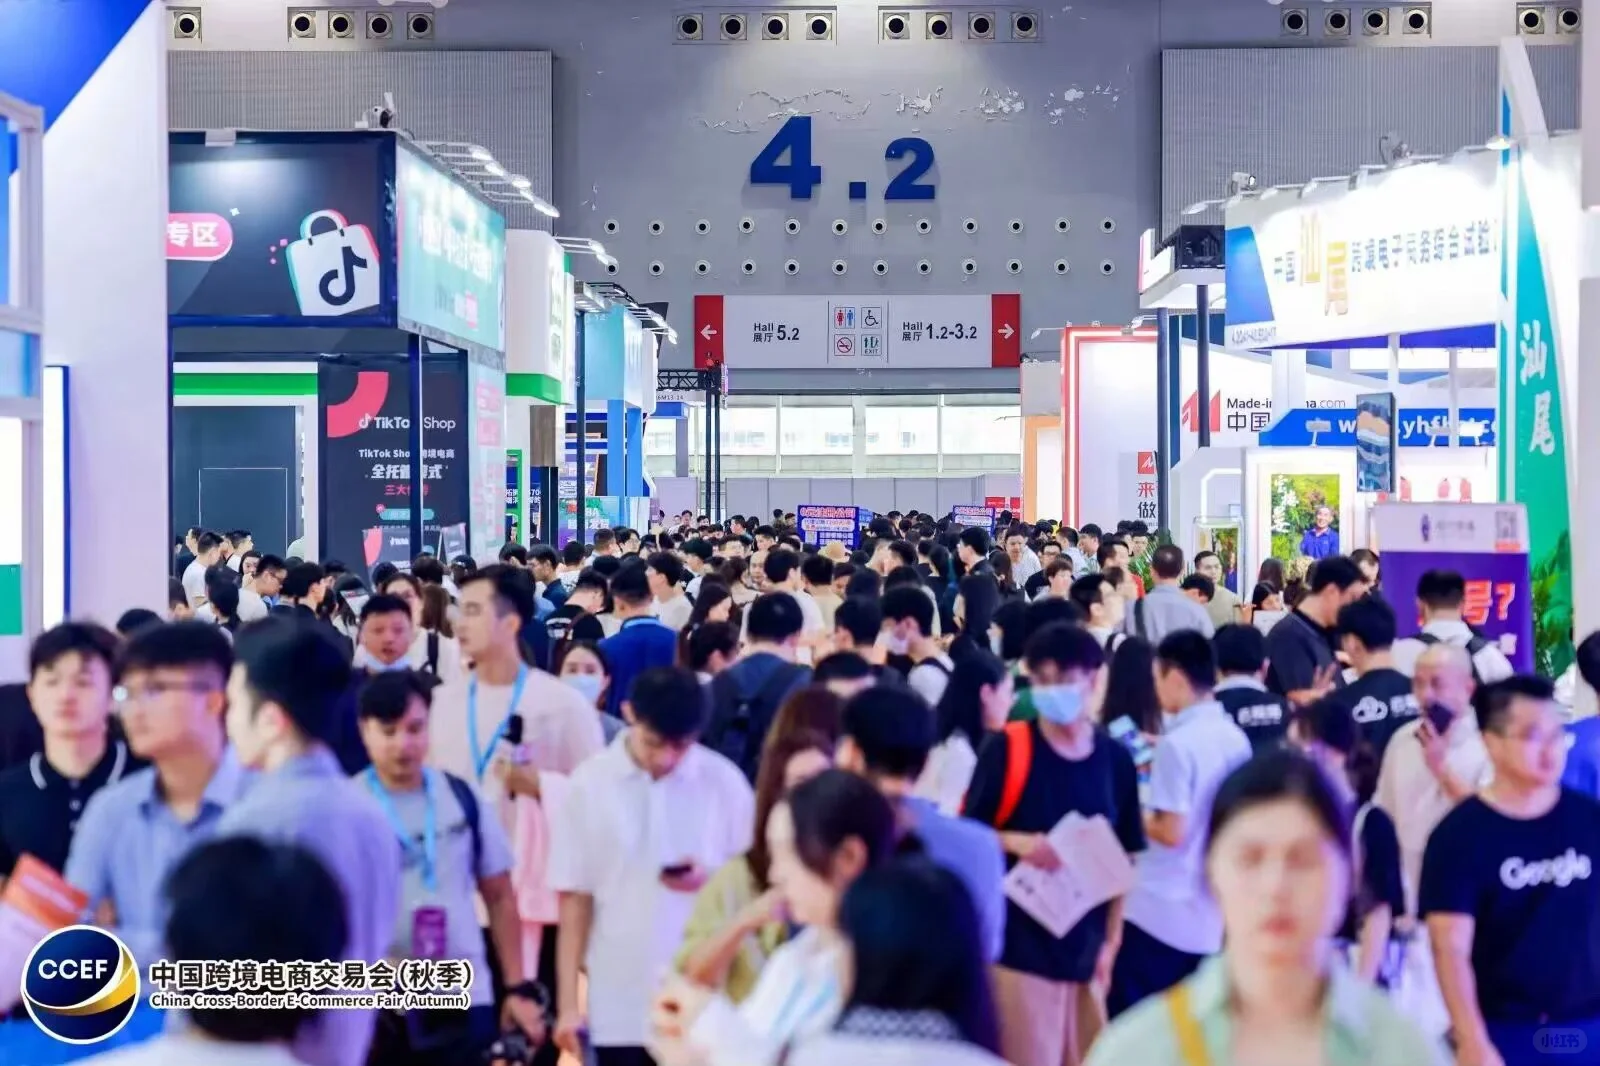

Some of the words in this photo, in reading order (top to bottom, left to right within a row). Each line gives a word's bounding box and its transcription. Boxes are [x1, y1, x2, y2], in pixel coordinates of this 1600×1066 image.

[751, 116, 935, 200] 4.2
[167, 221, 219, 248] 专区
[754, 322, 773, 331] Hall
[777, 324, 800, 340] 5.2
[903, 322, 922, 330] Hall
[926, 323, 977, 339] 1.2-3.2
[753, 332, 773, 342] 展厅
[902, 332, 922, 341] 展厅
[374, 416, 410, 429] TikTo
[423, 416, 456, 432] Shop
[358, 449, 391, 458] TikTok
[393, 449, 411, 458] Sho
